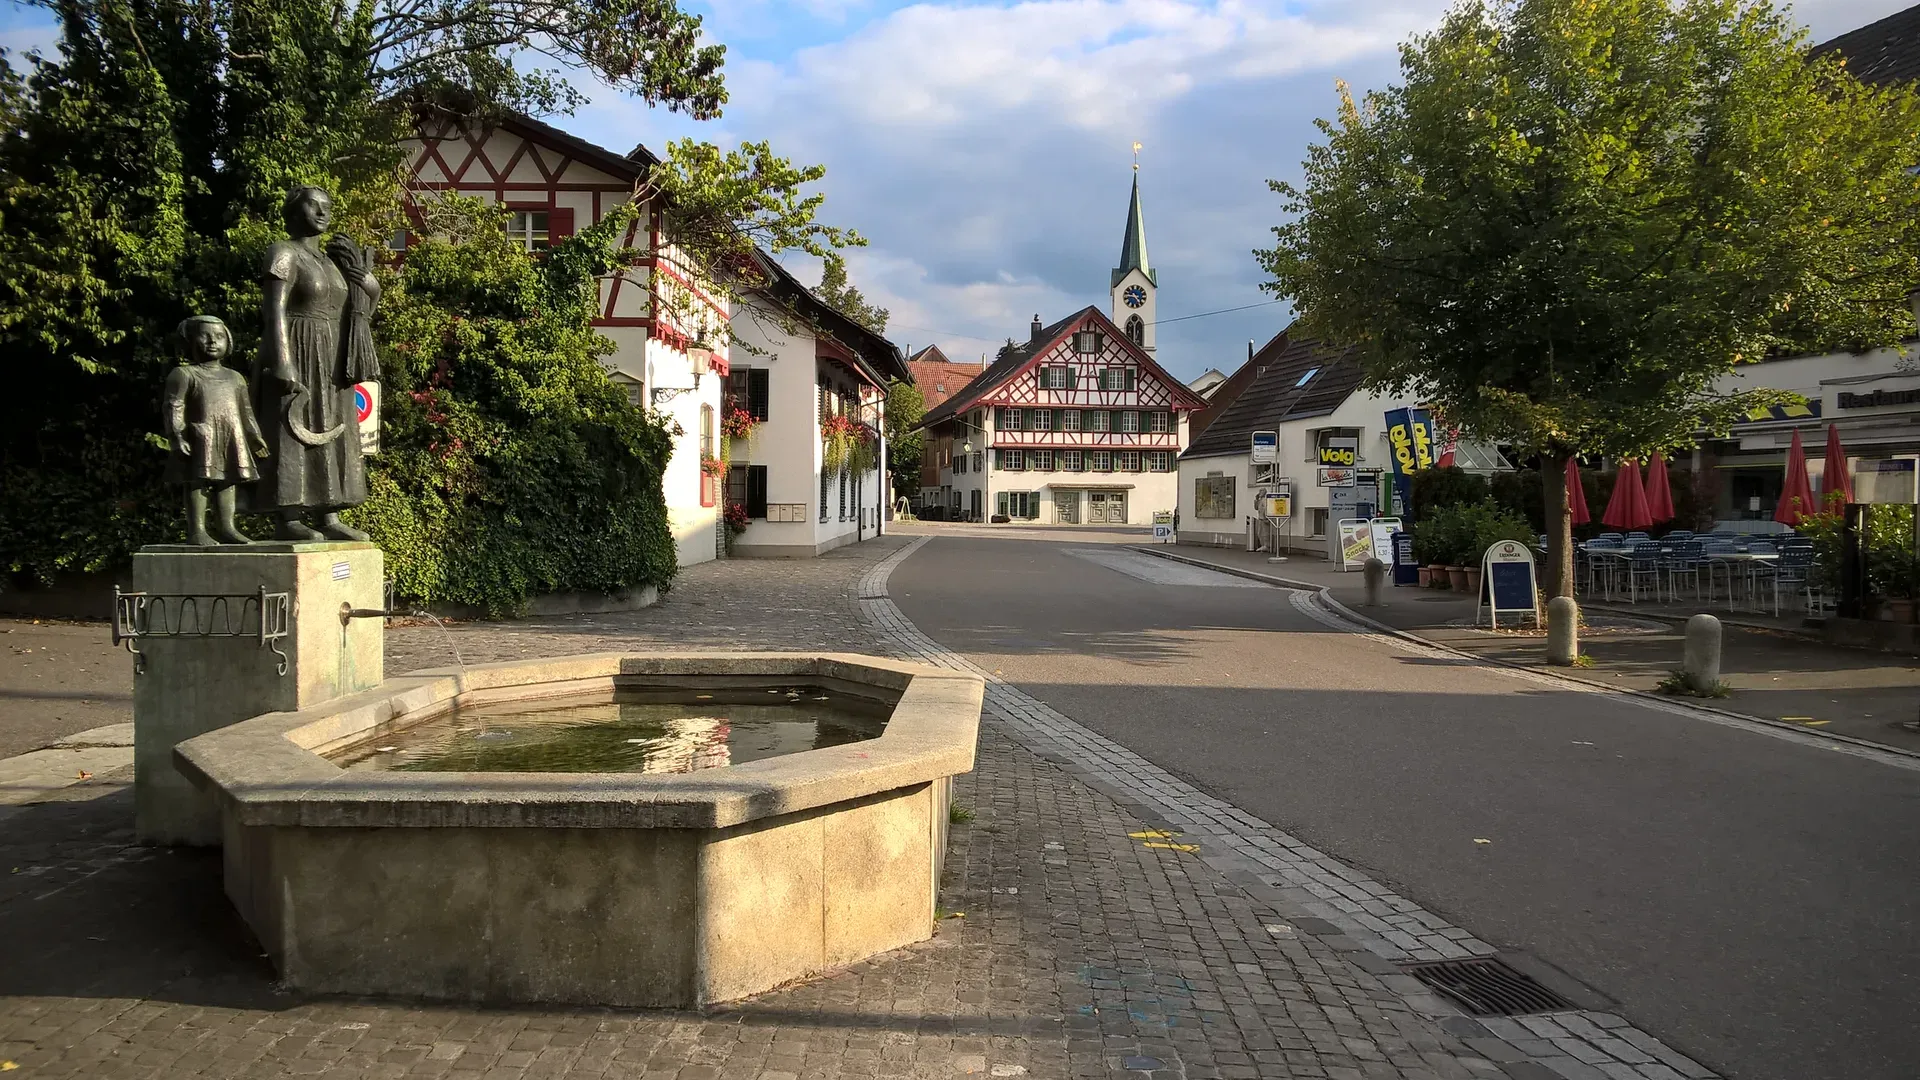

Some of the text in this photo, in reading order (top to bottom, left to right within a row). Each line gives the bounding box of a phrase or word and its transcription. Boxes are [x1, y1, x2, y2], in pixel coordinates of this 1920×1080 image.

[1321, 448, 1353, 465] Volg
[1390, 424, 1415, 474] Volg
[1345, 543, 1370, 559] Snacks
